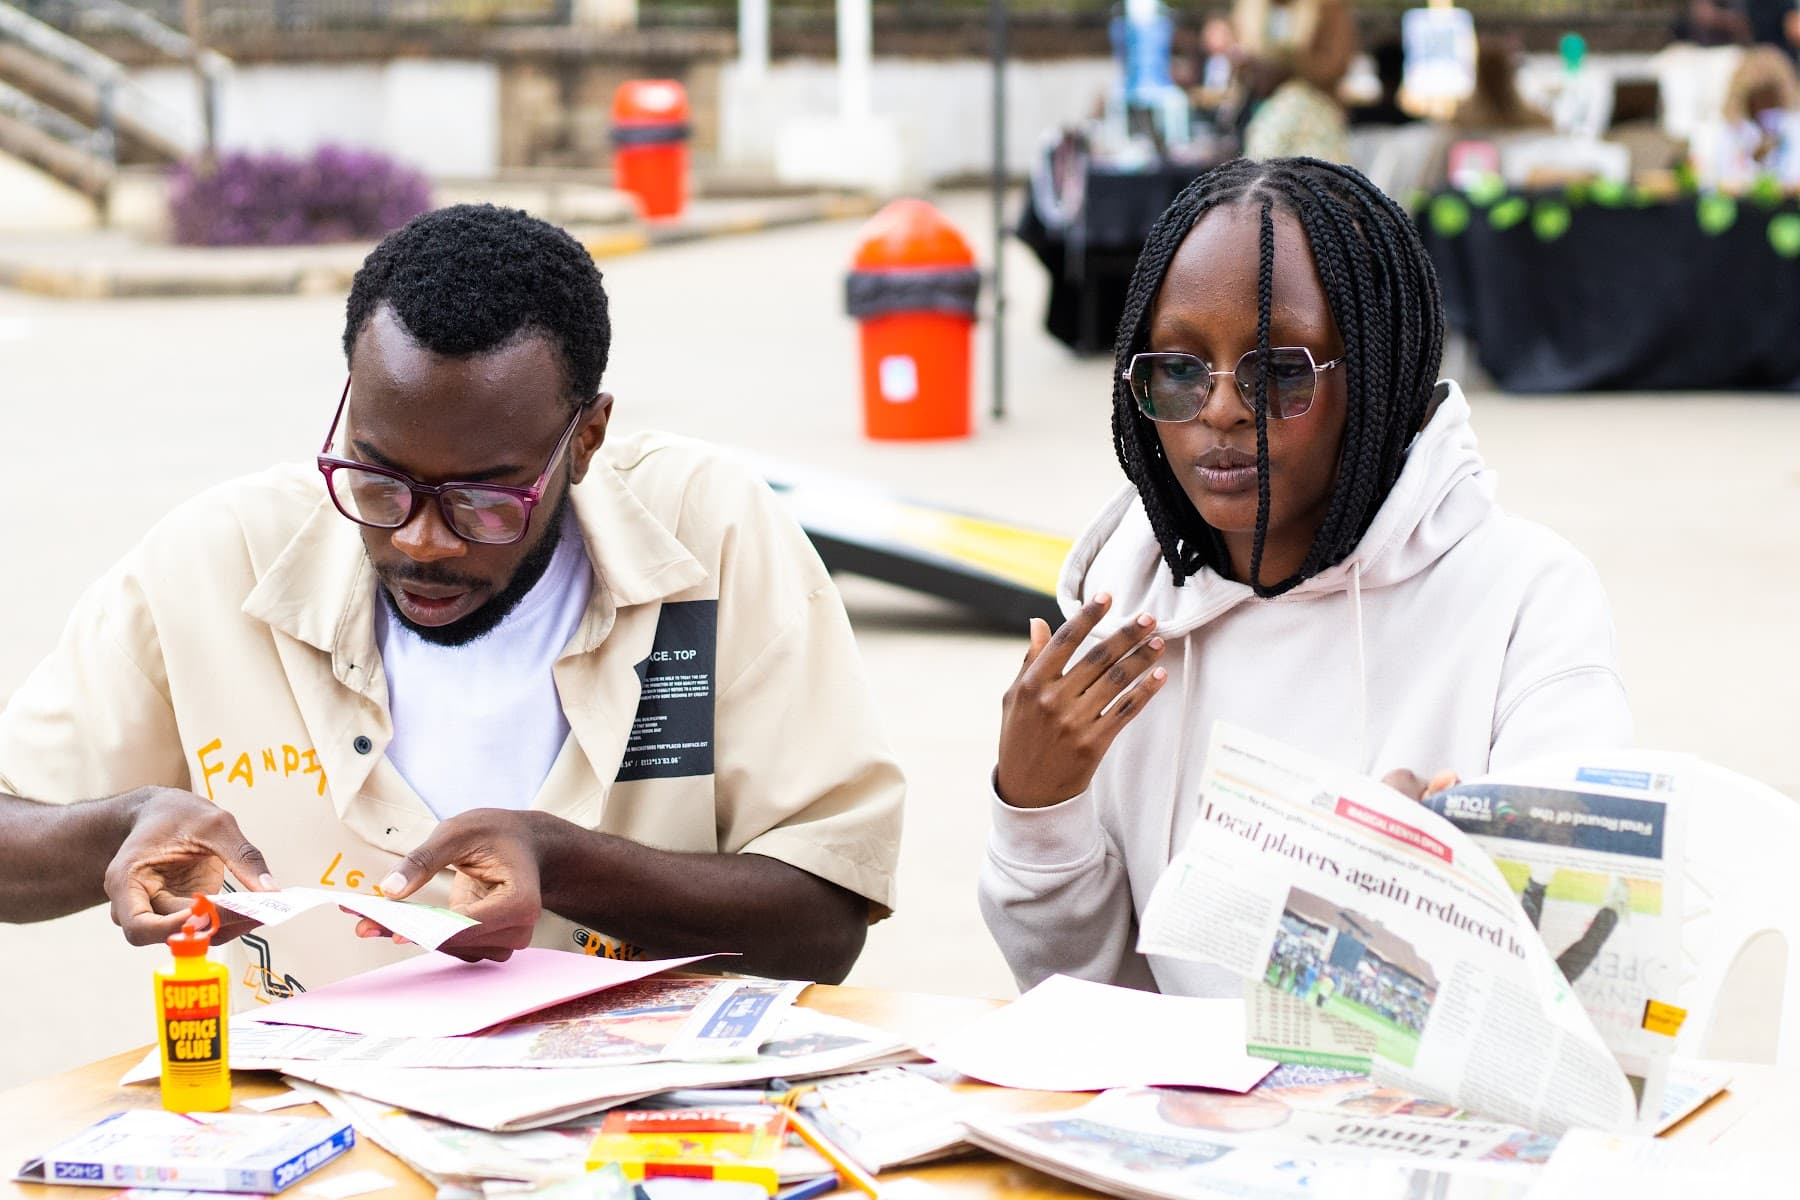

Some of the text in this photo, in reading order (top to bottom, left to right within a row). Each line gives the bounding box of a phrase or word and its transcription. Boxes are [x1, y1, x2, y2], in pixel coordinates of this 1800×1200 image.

[673, 649, 697, 661] TOP
[1445, 794, 1491, 814] TOUR
[1528, 806, 1653, 836] Final Round of the
[1203, 801, 1263, 842] Local
[1261, 832, 1340, 877] players
[1345, 867, 1411, 905] again
[1415, 894, 1504, 948] reduced
[1508, 935, 1527, 960] to
[164, 983, 220, 1010] SUPER
[168, 1018, 217, 1041] OFFICE
[174, 1038, 213, 1060] GLUE
